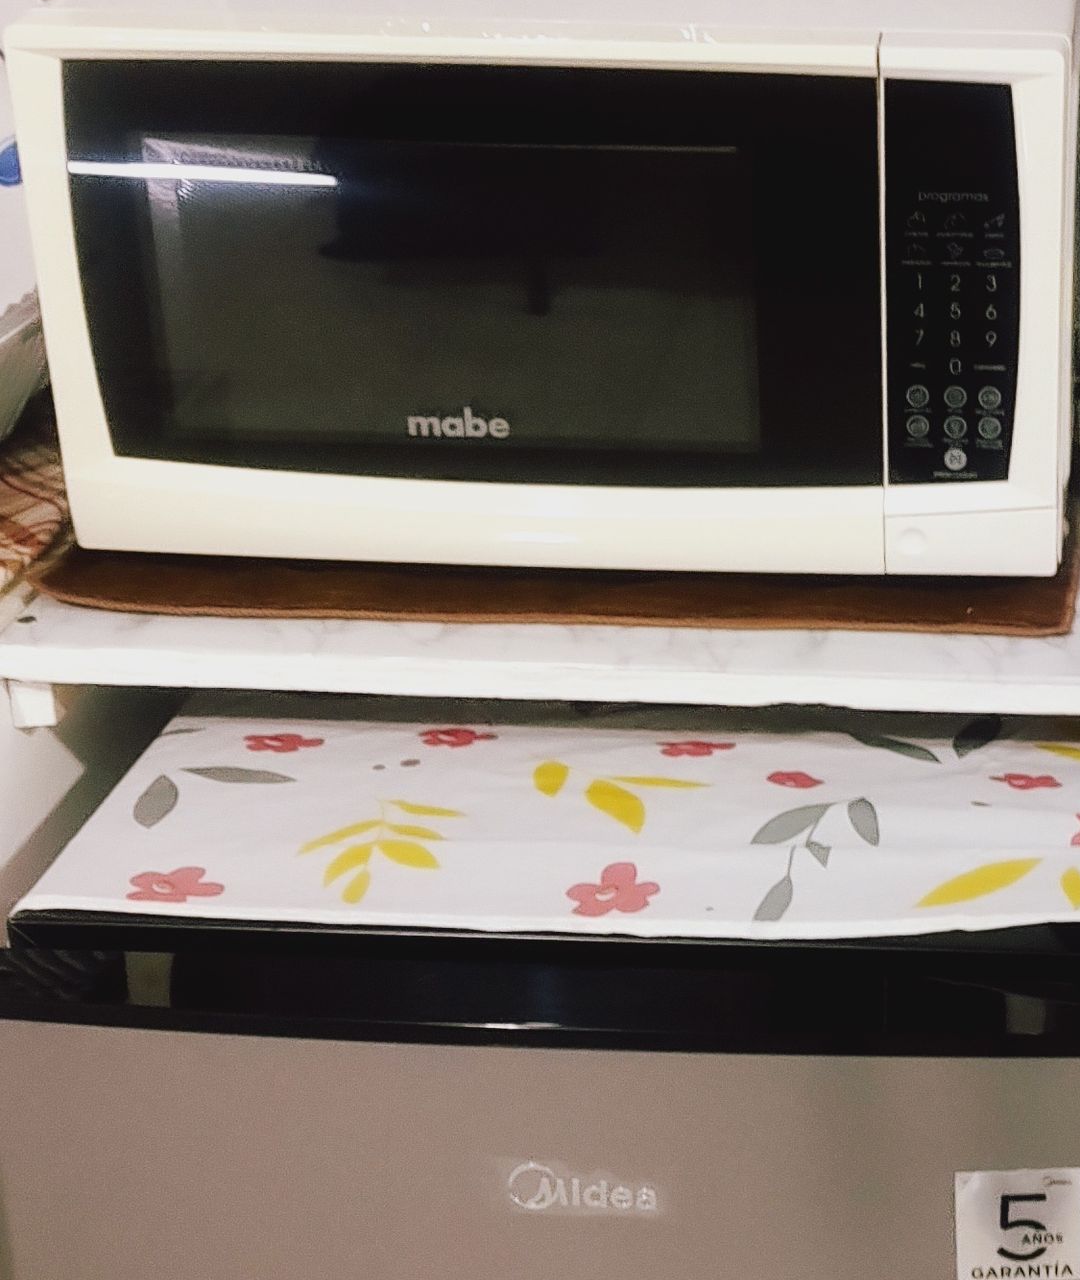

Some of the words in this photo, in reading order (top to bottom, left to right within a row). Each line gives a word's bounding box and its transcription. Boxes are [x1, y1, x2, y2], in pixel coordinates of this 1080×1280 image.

[950, 273, 961, 291] 2
[985, 274, 997, 292] 3
[913, 303, 924, 318] 4
[985, 304, 997, 320] 6
[914, 329, 924, 346] 7
[950, 330, 961, 347] 8
[985, 330, 997, 347] 9
[407, 406, 511, 438] mabe
[508, 1160, 657, 1211] Midea
[997, 1193, 1047, 1261] 5
[1021, 1229, 1063, 1245] AÑOS
[971, 1260, 1073, 1280] GARANTÍA
